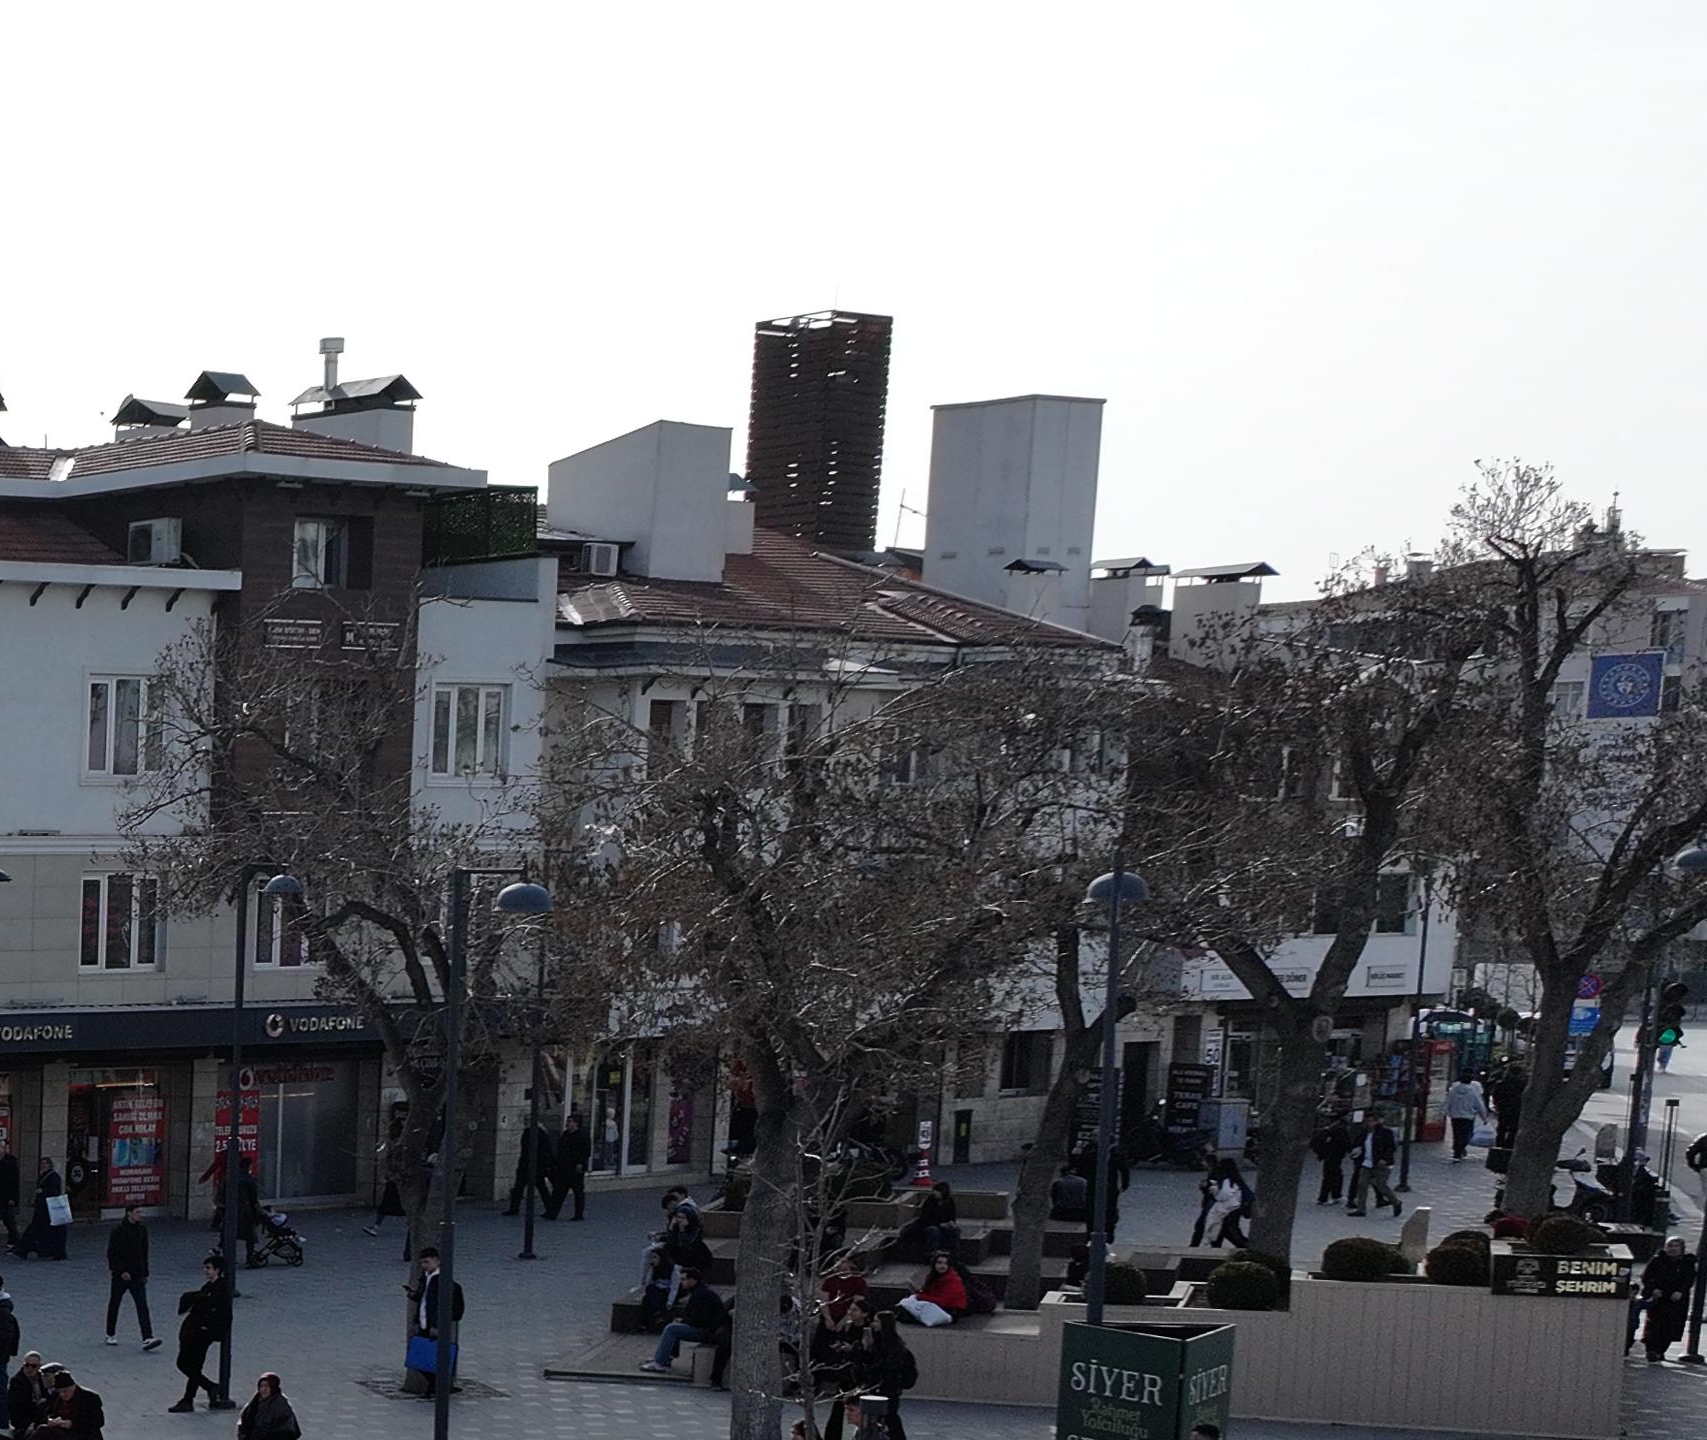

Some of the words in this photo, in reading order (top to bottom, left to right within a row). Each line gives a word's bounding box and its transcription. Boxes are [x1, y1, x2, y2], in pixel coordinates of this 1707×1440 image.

[289, 1016, 364, 1032] VODAFONE
[1070, 1359, 1163, 1406] SİYER
[1189, 1364, 1228, 1405] SİYER
